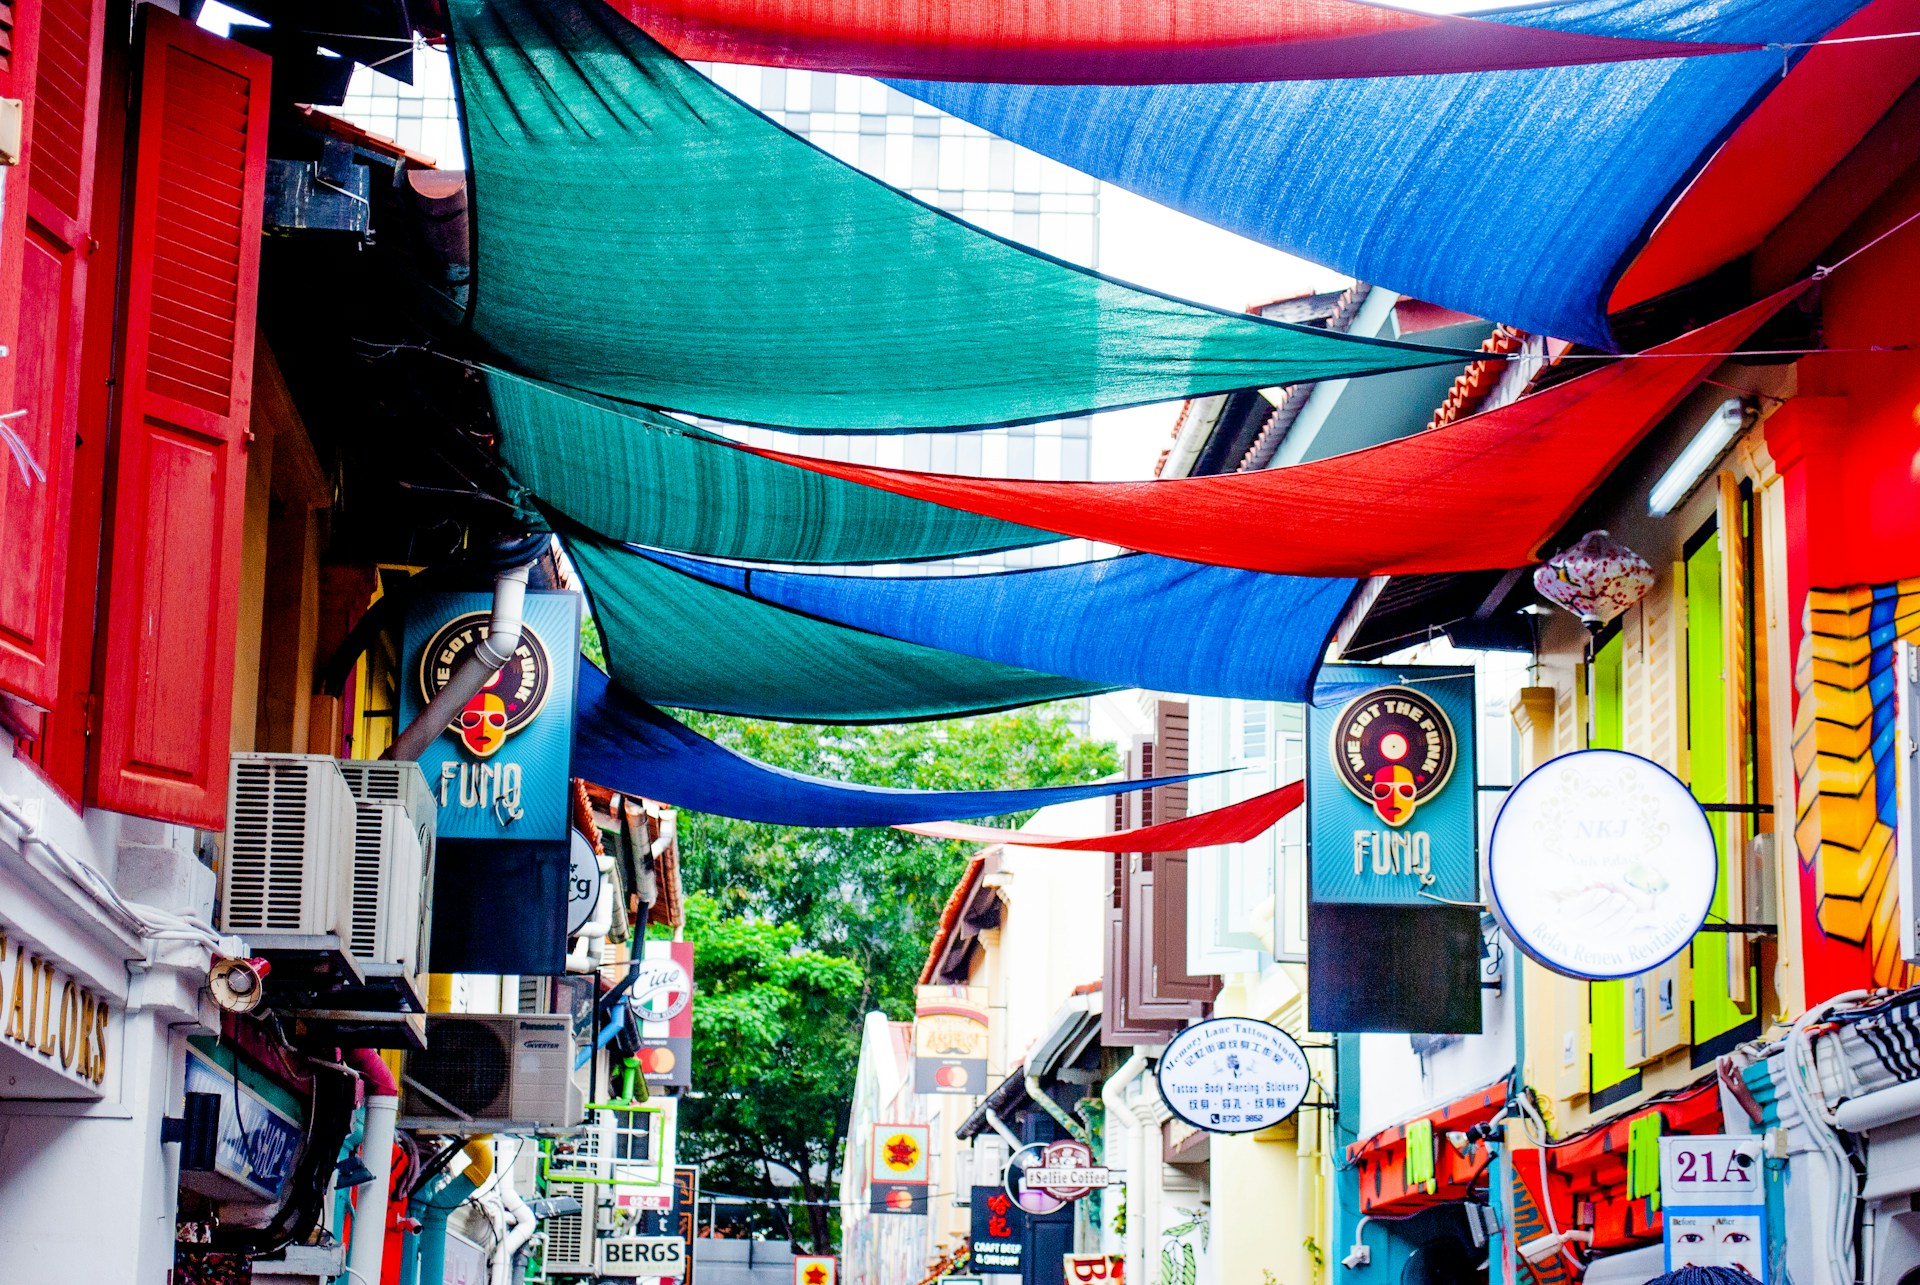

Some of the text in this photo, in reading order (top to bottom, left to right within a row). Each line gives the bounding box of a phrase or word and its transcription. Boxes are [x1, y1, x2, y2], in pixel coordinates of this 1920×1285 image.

[440, 629, 474, 665] GOT
[514, 644, 536, 703] FUNK
[1347, 701, 1441, 774] WE GOT THE FUNK
[441, 761, 524, 820] FUNQ
[1354, 829, 1436, 885] FUNQ
[1532, 911, 1691, 966] Relax Renew Revitalize
[632, 967, 680, 1000] Ciao
[1165, 1023, 1303, 1072] Memory Lane Tattoo Studio
[1071, 1171, 1107, 1185] Coffee
[629, 1196, 661, 1207] 02-02
[1673, 1218, 1736, 1226] Before After
[606, 1243, 680, 1263] BERGS
[974, 1242, 1023, 1255] CRAFT BEER
[975, 1253, 984, 1265] &
